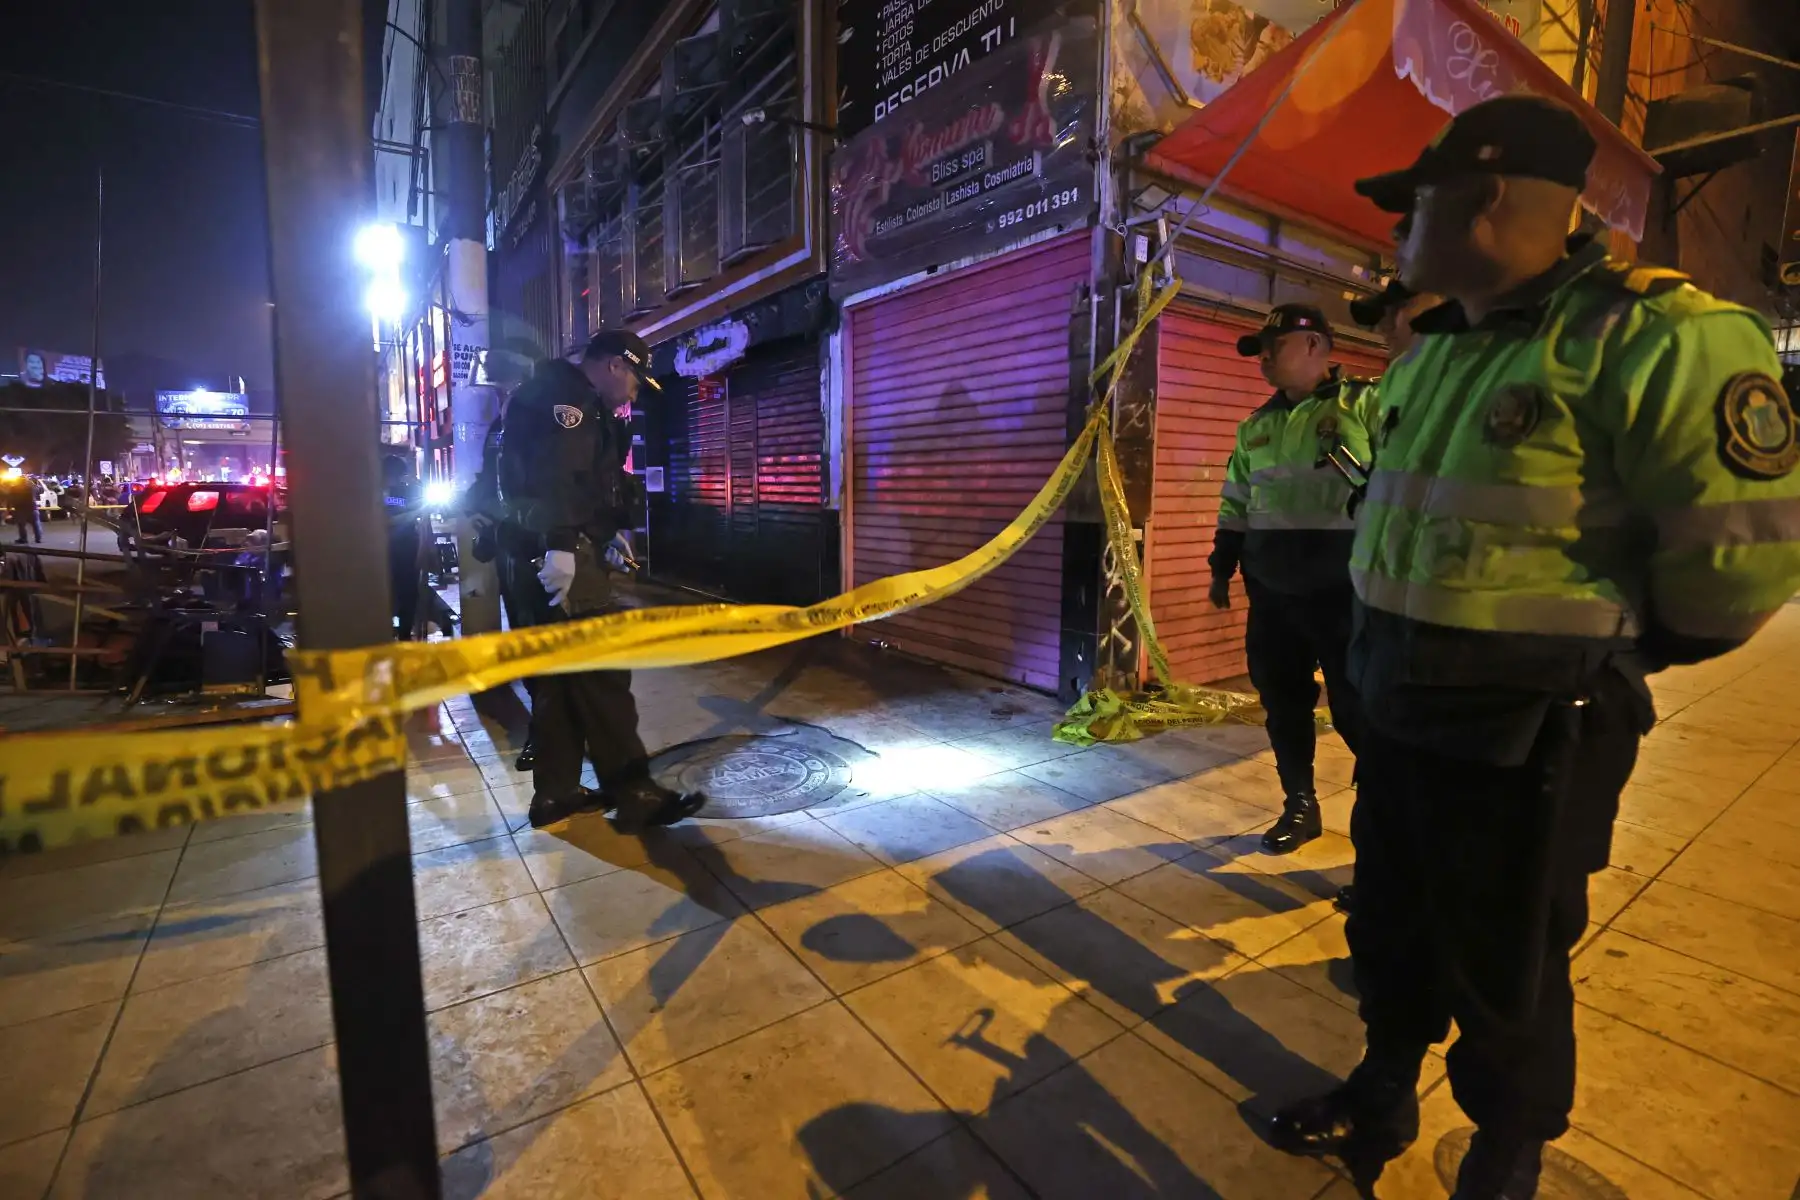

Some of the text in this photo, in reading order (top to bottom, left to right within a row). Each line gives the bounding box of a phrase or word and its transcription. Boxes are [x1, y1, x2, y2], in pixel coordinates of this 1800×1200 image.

[882, 3, 915, 36] JARRA
[882, 20, 914, 54] FOTOS
[881, 40, 912, 69] TORTA
[881, 56, 912, 86] VALES
[915, 43, 930, 64] DE
[932, 146, 984, 183] Bliss spa
[876, 155, 1033, 235] Estilista Colorista Lashista Cosmiatria
[999, 187, 1078, 228] 992 011 391
